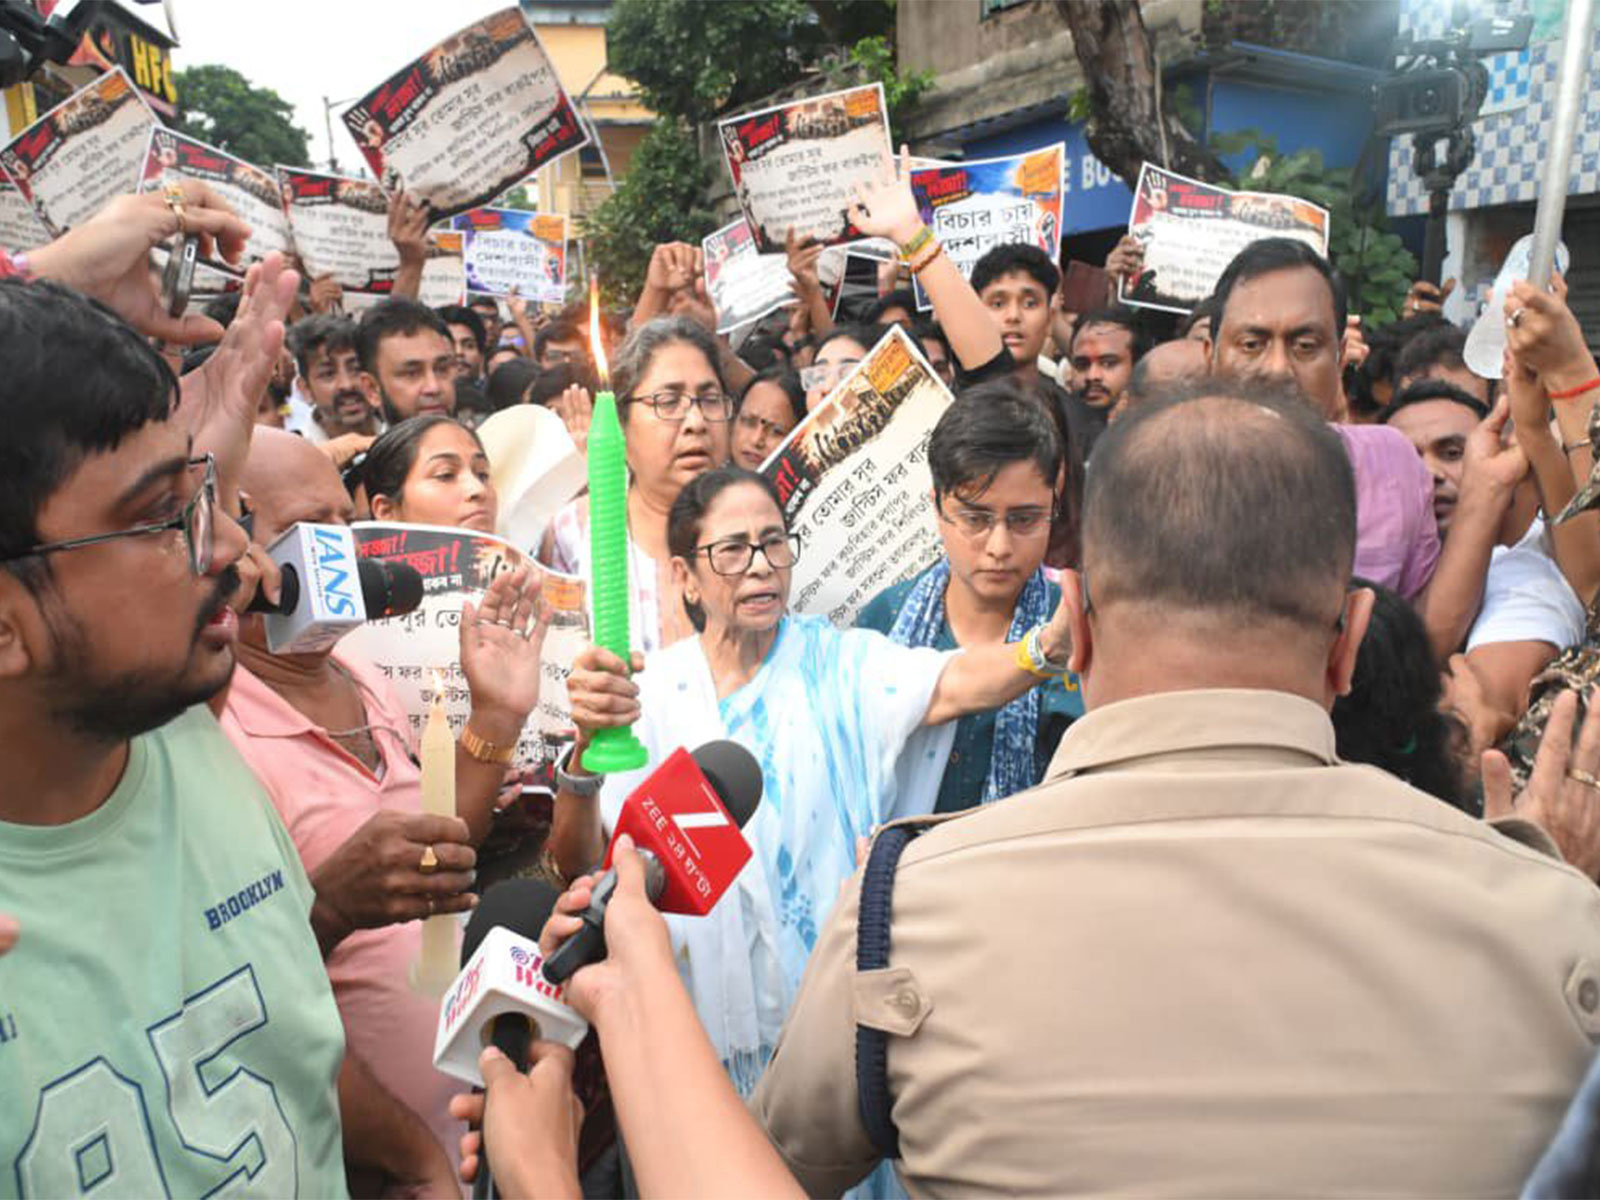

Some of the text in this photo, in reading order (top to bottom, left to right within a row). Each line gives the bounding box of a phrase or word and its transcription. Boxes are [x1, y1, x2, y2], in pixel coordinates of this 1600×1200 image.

[936, 206, 991, 231] বিচার
[809, 477, 856, 525] তোমার
[852, 456, 876, 482] সুর
[838, 480, 886, 529] জাস্টিস
[882, 460, 909, 487] ফর
[314, 528, 356, 617] IANS
[641, 795, 668, 832] ZEE
[203, 869, 285, 932] BROOKLYN
